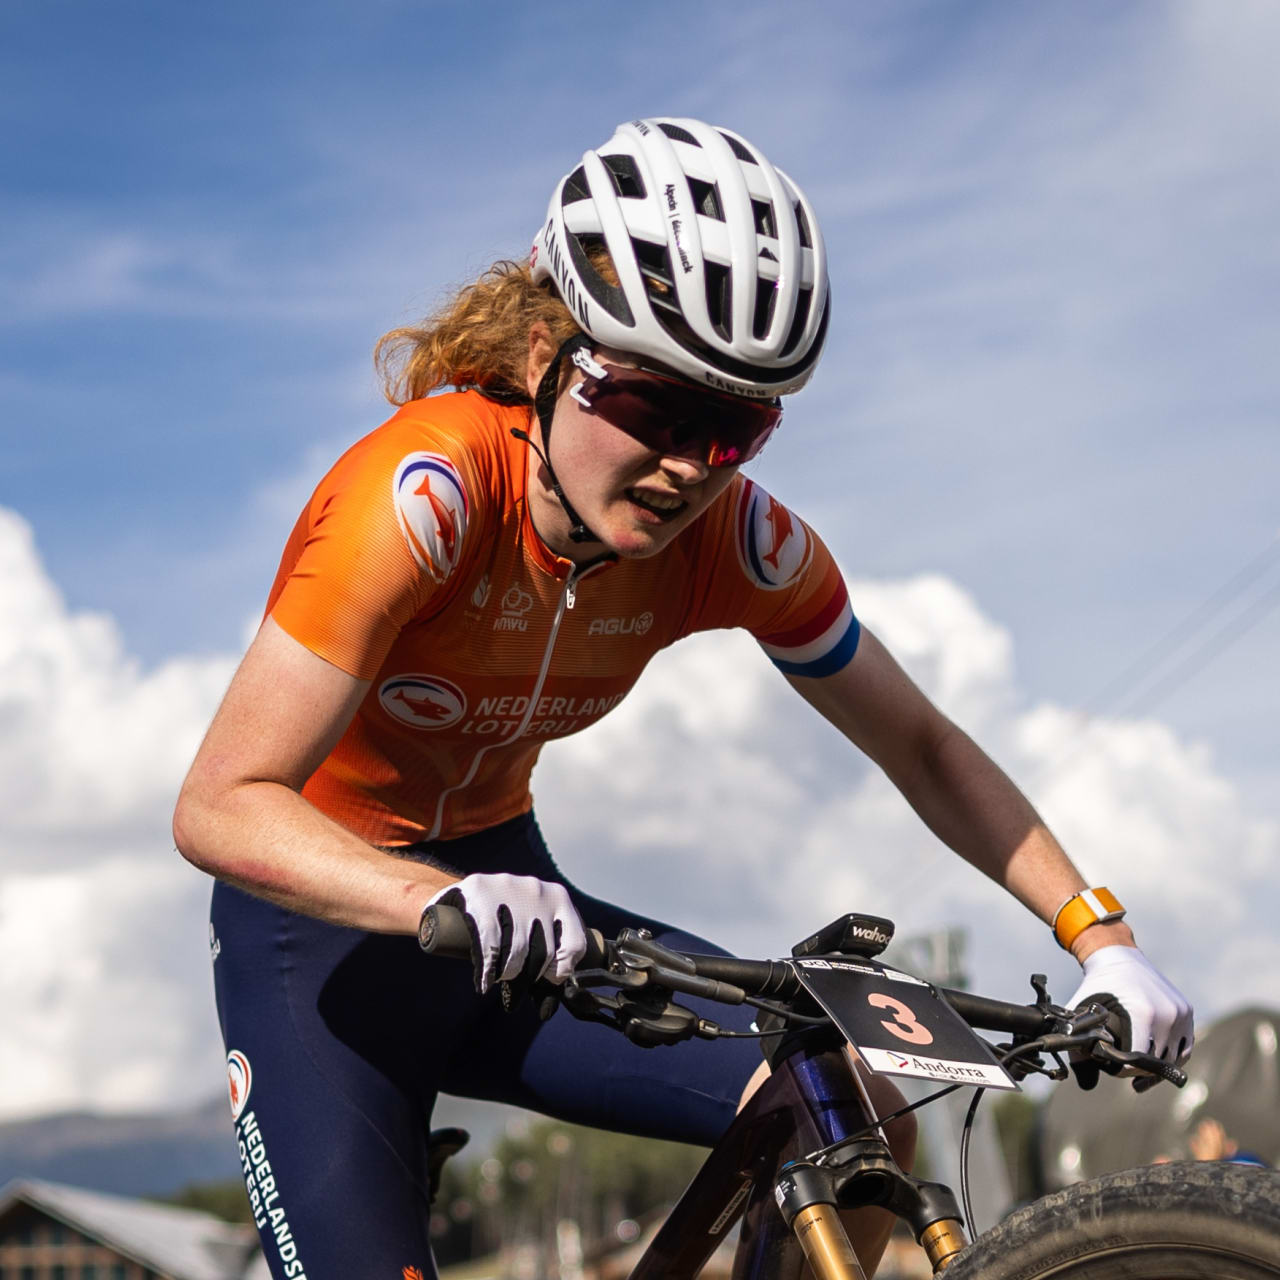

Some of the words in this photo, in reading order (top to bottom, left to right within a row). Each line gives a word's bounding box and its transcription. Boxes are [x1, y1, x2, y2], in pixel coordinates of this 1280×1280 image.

[544, 217, 593, 334] CANYON
[705, 371, 769, 397] CANYON
[587, 617, 636, 636] AGU
[867, 992, 934, 1046] 3
[912, 1056, 987, 1080] Andorra
